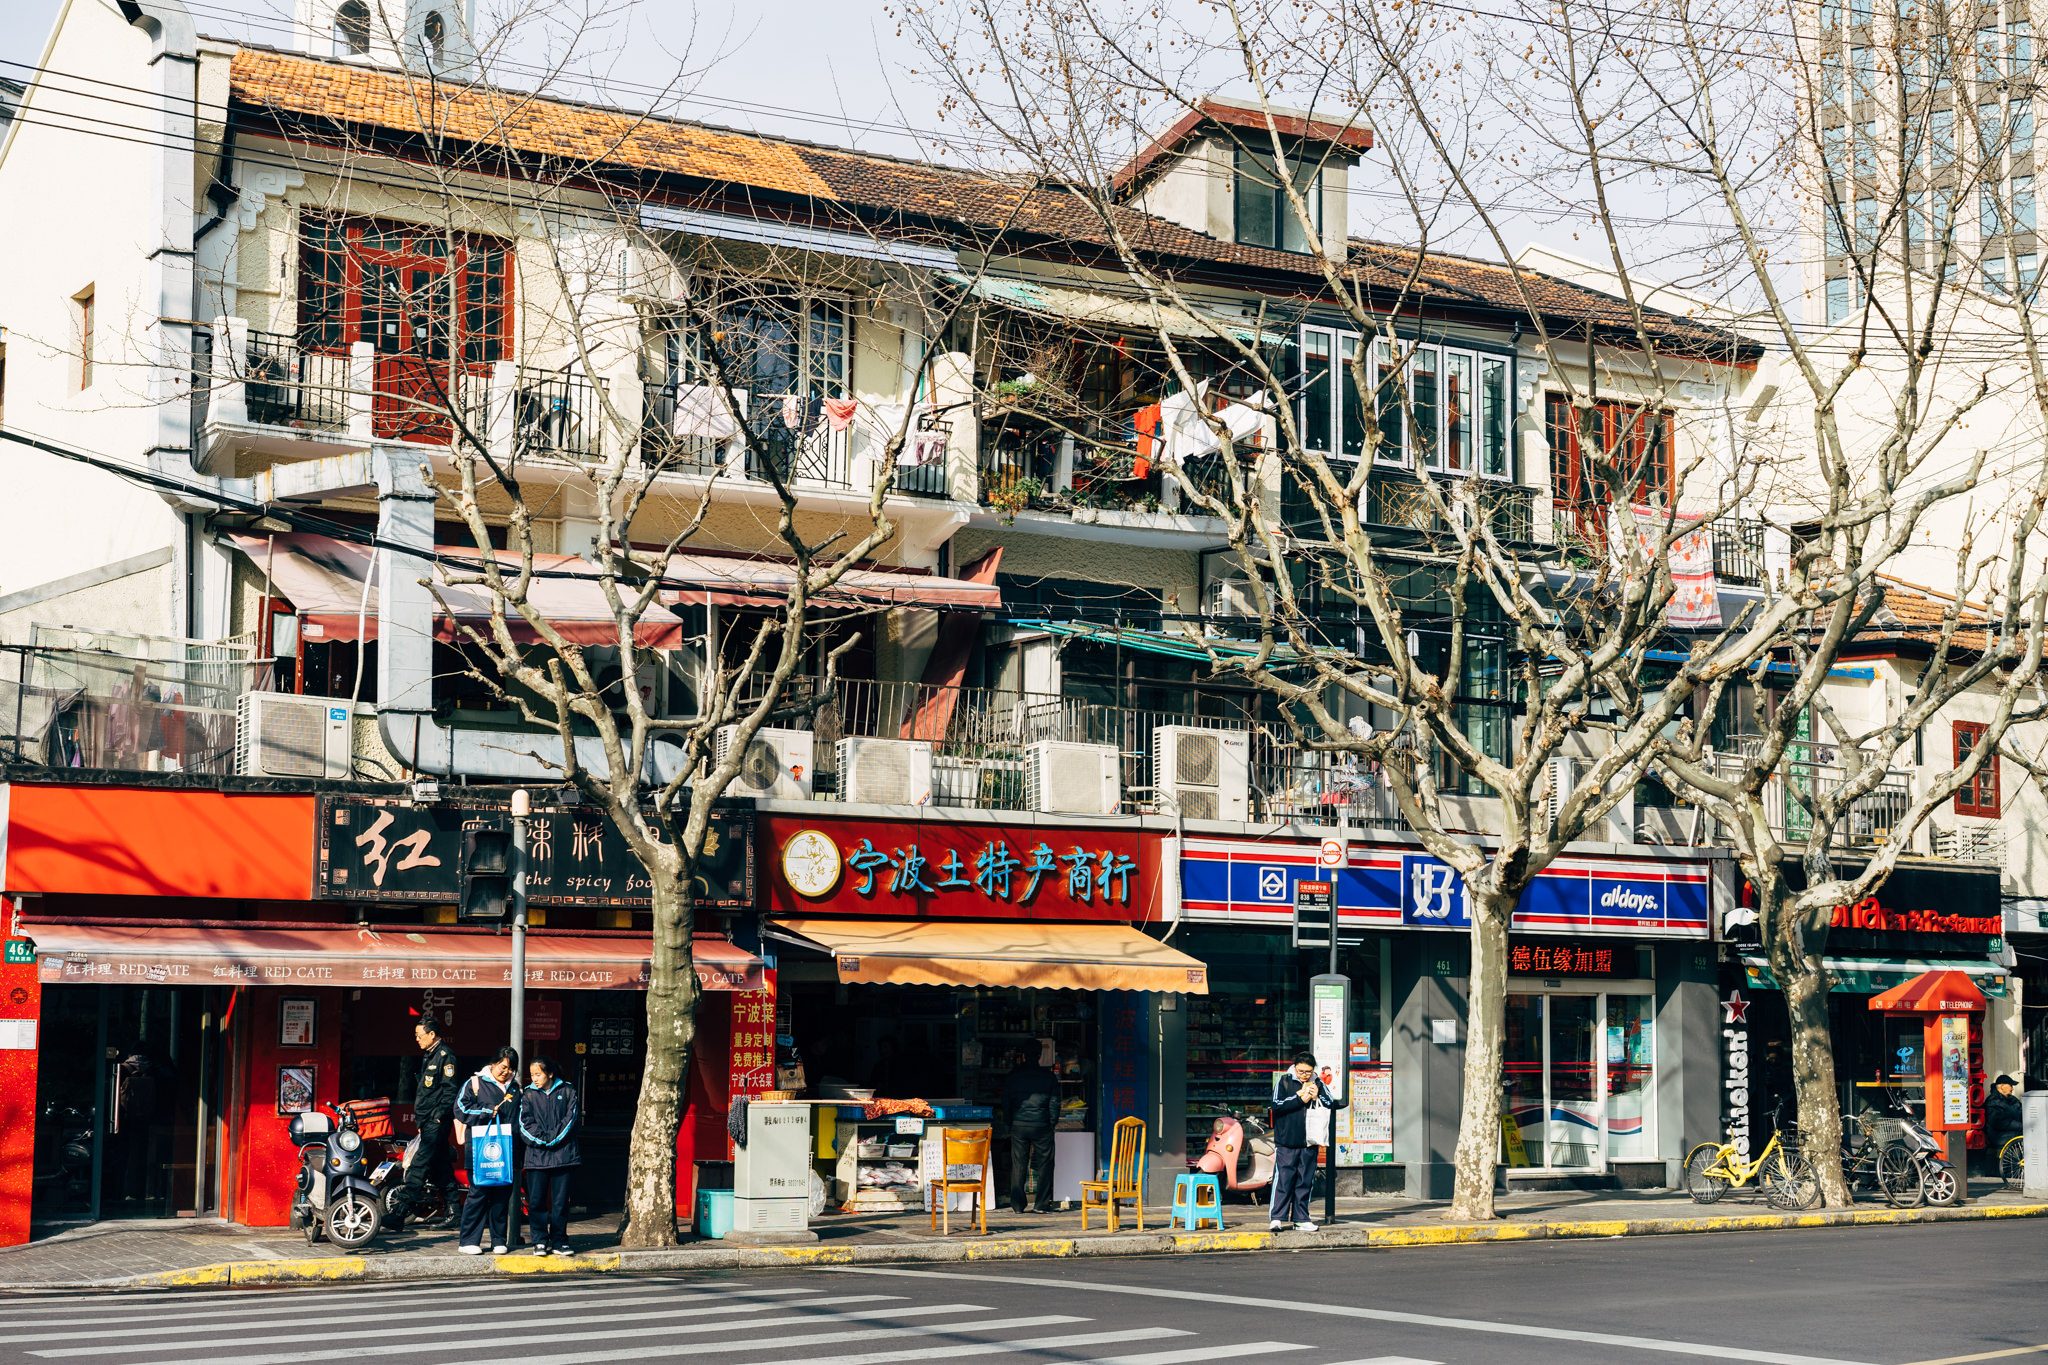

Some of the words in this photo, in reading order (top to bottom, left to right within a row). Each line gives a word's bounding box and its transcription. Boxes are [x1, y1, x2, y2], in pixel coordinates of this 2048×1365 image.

[848, 838, 1136, 903] 宁波土特产商行
[526, 871, 552, 886] the
[566, 873, 612, 892] spicy
[626, 873, 653, 892] foo
[1300, 893, 1310, 901] 838
[1411, 863, 1471, 919] 好
[1990, 938, 2001, 947] 457
[66, 963, 112, 976] 红料理
[119, 963, 147, 976] RED
[213, 964, 258, 978] 红料理
[264, 966, 291, 978] RED
[297, 967, 333, 978] CATE
[1436, 960, 1451, 970] 461
[362, 966, 405, 980] 红料理
[411, 968, 438, 980] RED
[442, 969, 477, 980] CATE
[550, 970, 576, 982] RED
[579, 970, 613, 982] CATE
[712, 972, 743, 984] CATE
[733, 1003, 774, 1023] 宁波菜
[733, 1032, 773, 1047] 量身定制
[733, 1052, 773, 1067] 免费推荐
